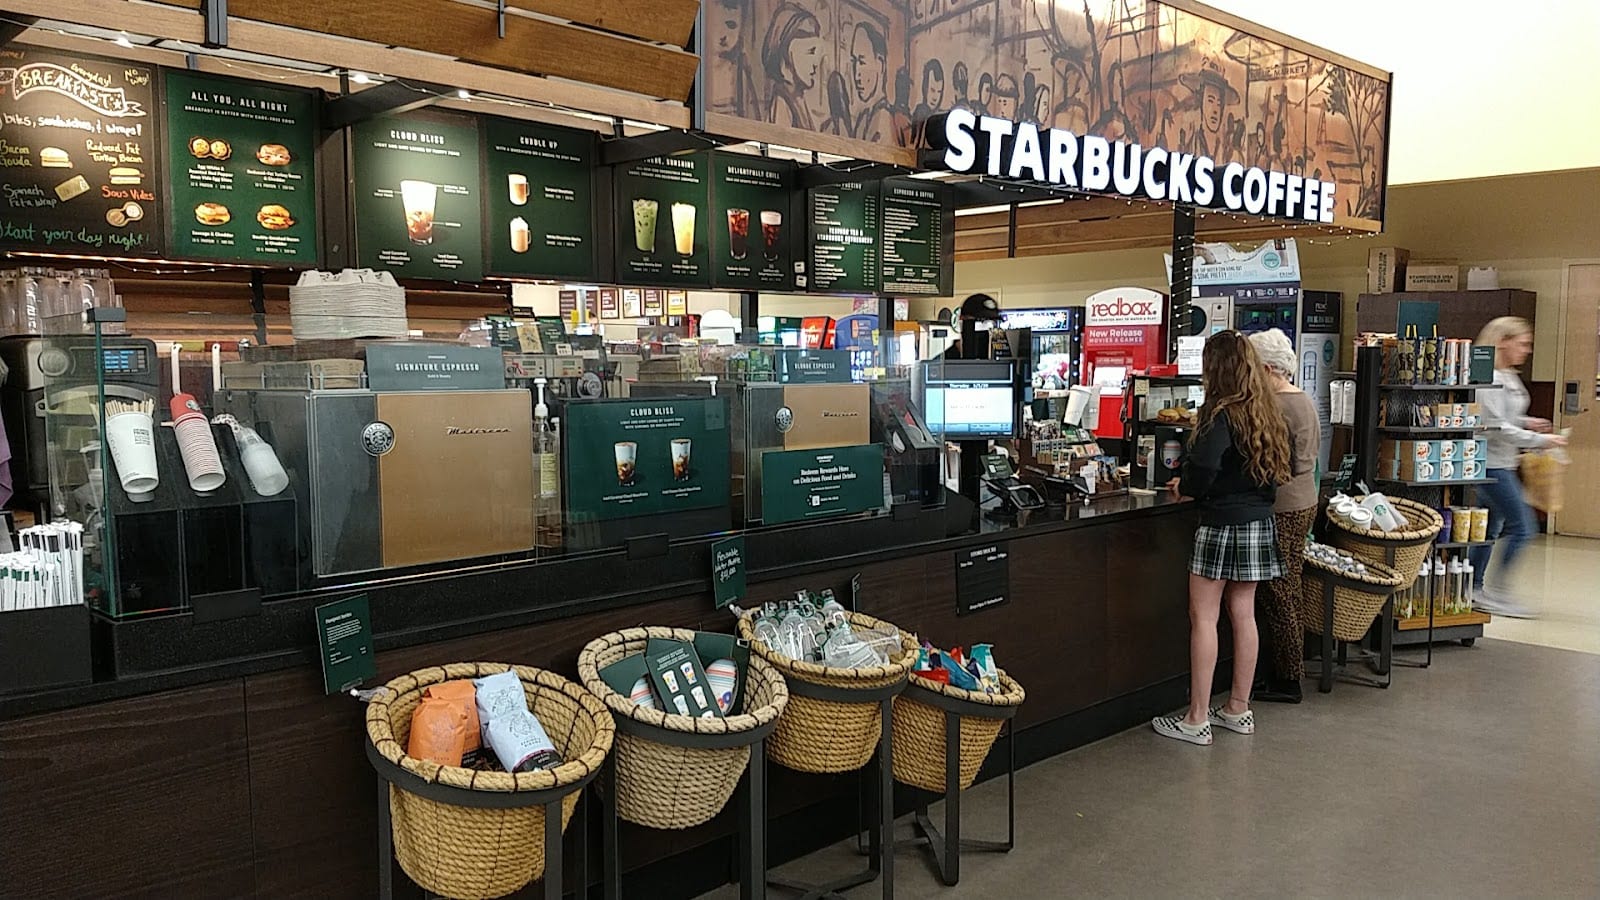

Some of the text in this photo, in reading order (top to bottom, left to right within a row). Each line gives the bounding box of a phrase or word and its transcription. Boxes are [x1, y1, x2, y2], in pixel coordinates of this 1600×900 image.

[124, 70, 138, 82] No
[19, 69, 112, 109] BREAKFAST
[191, 91, 209, 102] ALL
[240, 98, 257, 109] ALL
[260, 100, 288, 113] RIGHT
[105, 123, 142, 137] wraps!
[390, 130, 445, 145] CLOUD BLISS
[85, 139, 123, 153] Reduced
[125, 142, 141, 155] Fat
[548, 140, 558, 150] UP
[119, 153, 144, 164] Bacon
[727, 166, 780, 180] DELIGHTFULLY CHILL
[943, 108, 1337, 224] STARBUCKS COFFEE
[2, 183, 155, 201] Spinach Sous Vides
[42, 229, 75, 246] your
[77, 226, 103, 248] day
[395, 363, 480, 371] SIGNATURE ESPRESSO
[630, 407, 674, 417] CLOUD BLISS
